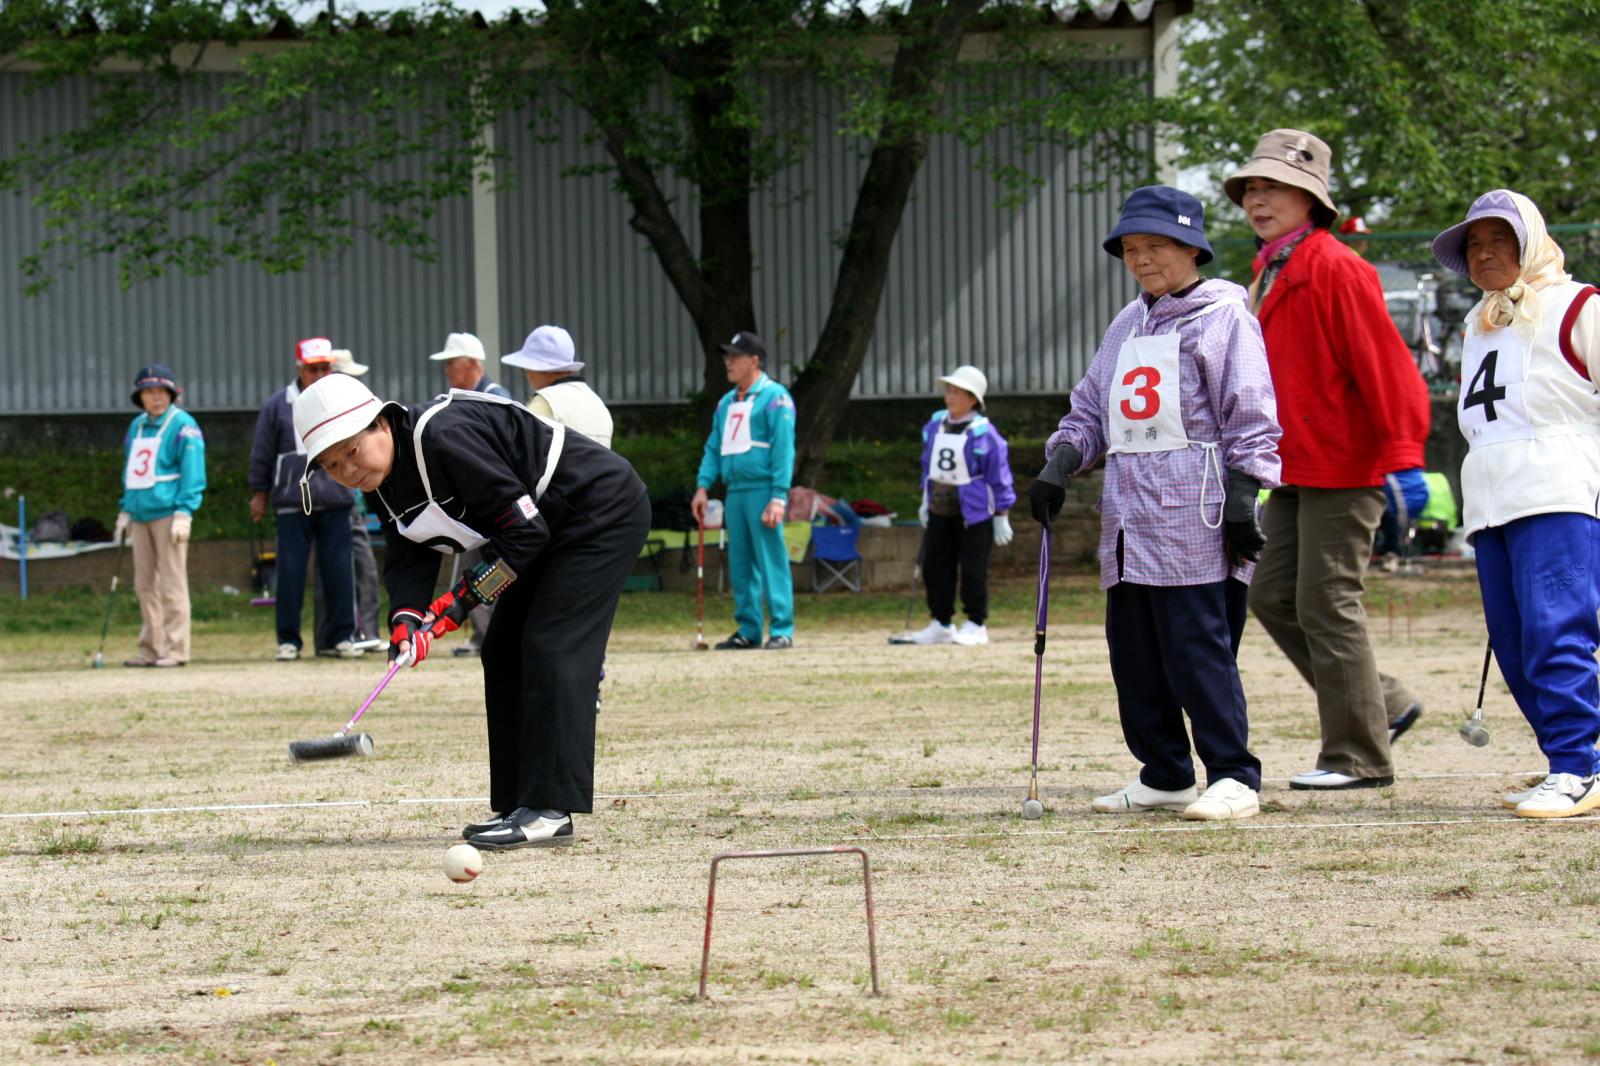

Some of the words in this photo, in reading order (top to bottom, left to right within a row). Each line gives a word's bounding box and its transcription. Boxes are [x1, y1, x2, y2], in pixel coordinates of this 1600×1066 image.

[1120, 366, 1162, 420] 3
[1463, 350, 1506, 422] 4
[730, 412, 744, 442] 7
[133, 448, 152, 477] 3
[938, 448, 956, 471] 8
